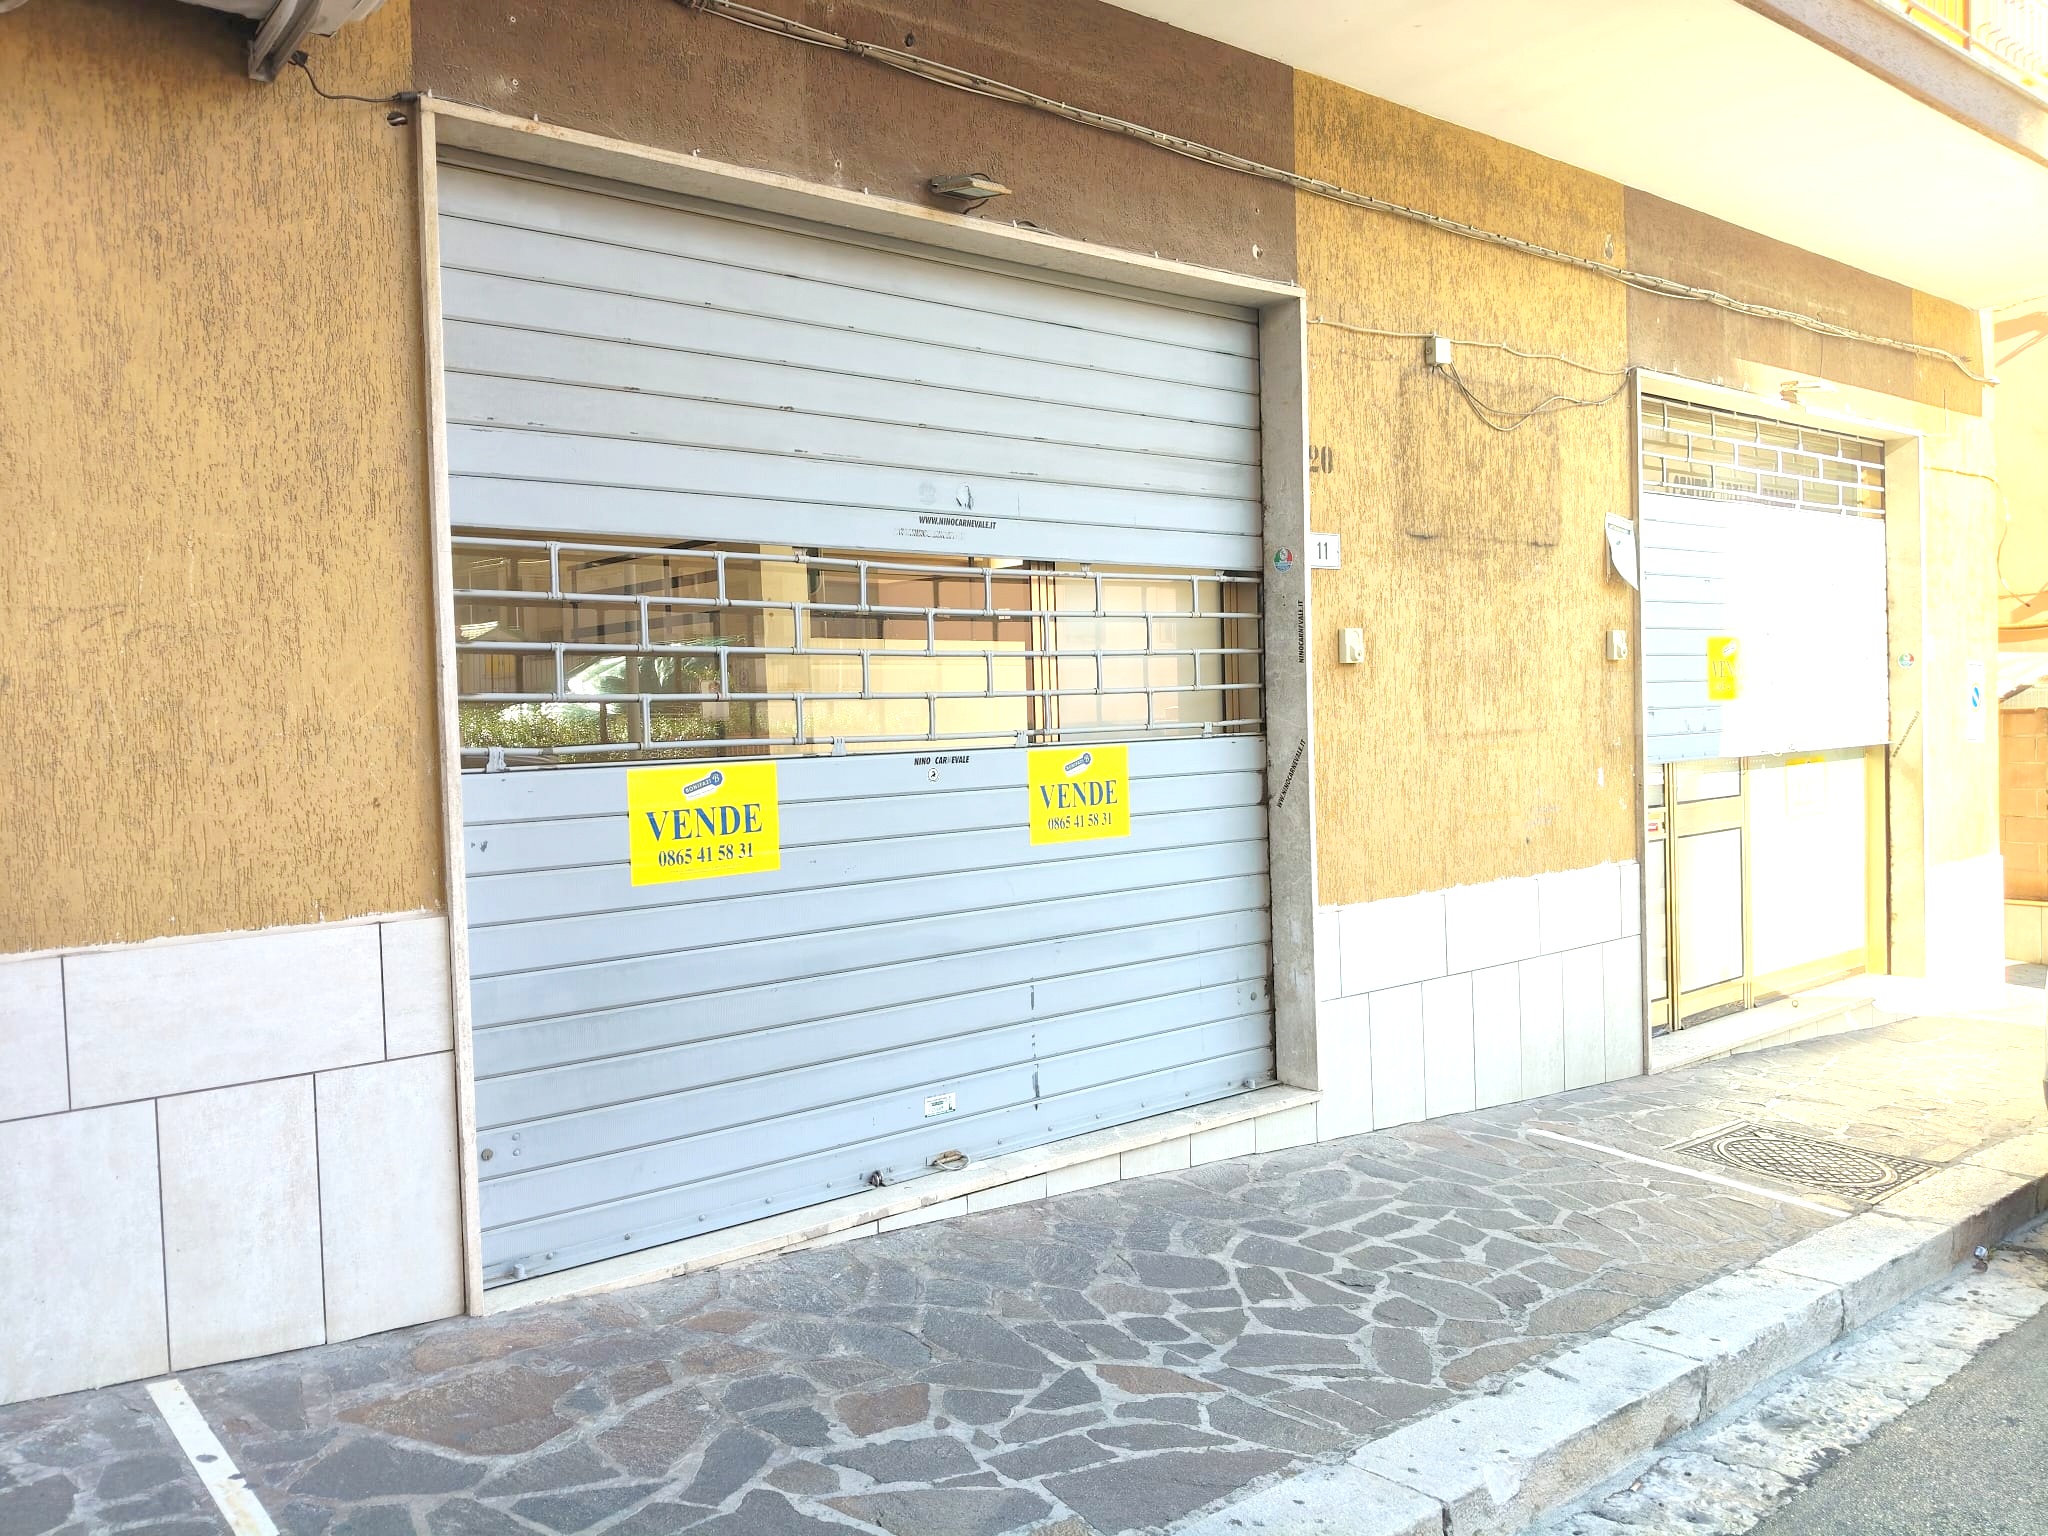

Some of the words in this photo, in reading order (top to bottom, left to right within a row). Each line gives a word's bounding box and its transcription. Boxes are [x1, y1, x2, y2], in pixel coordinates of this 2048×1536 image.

[1308, 445, 1333, 474] 20
[918, 515, 997, 530] WWW.NINOCARNEVALE.IT
[1316, 541, 1328, 561] 11
[914, 756, 931, 766] NINO
[1039, 779, 1118, 810] VENDE
[645, 803, 763, 842] VENDE
[1047, 815, 1071, 831] 0865
[1073, 814, 1085, 828] 41
[1087, 812, 1099, 827] 58
[1101, 811, 1112, 826] 31
[658, 848, 693, 867] 0865
[696, 846, 713, 863] 41
[718, 844, 734, 861] 58
[738, 842, 753, 859] 31
